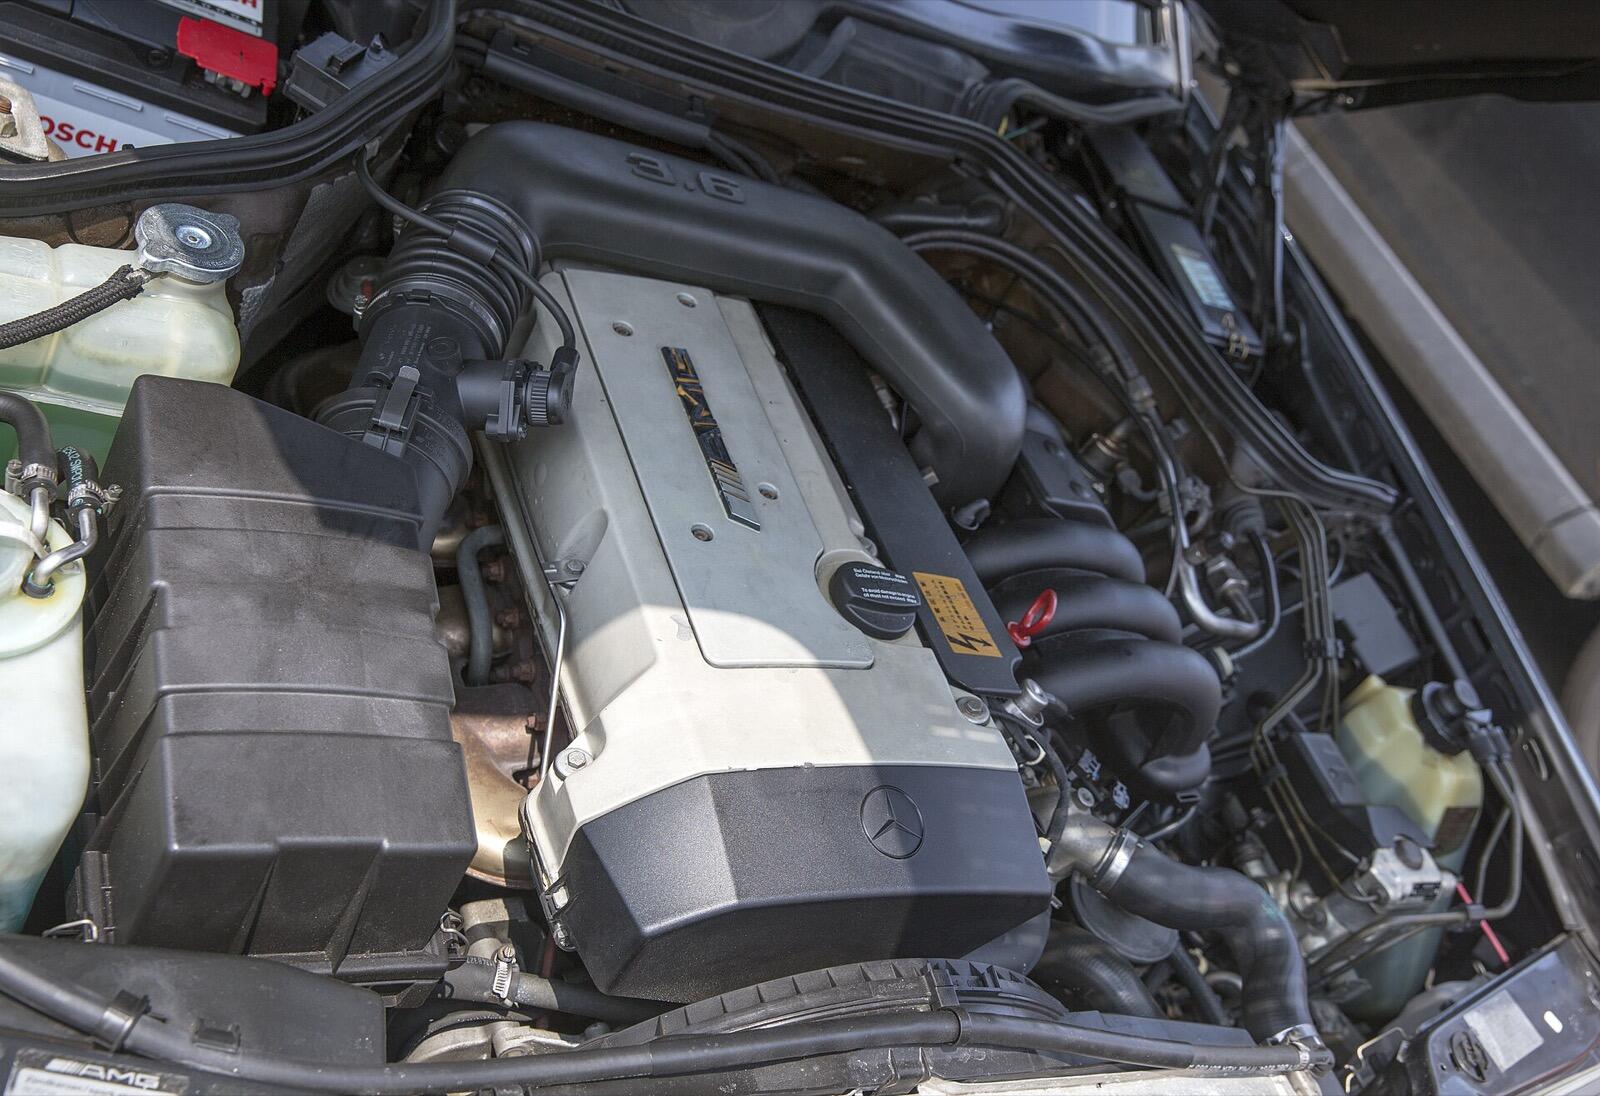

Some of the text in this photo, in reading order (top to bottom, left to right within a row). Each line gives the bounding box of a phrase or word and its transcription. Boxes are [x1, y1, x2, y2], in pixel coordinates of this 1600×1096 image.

[40, 114, 118, 153] OSCH
[626, 152, 745, 204] 3.6
[79, 1064, 160, 1089] AMG
